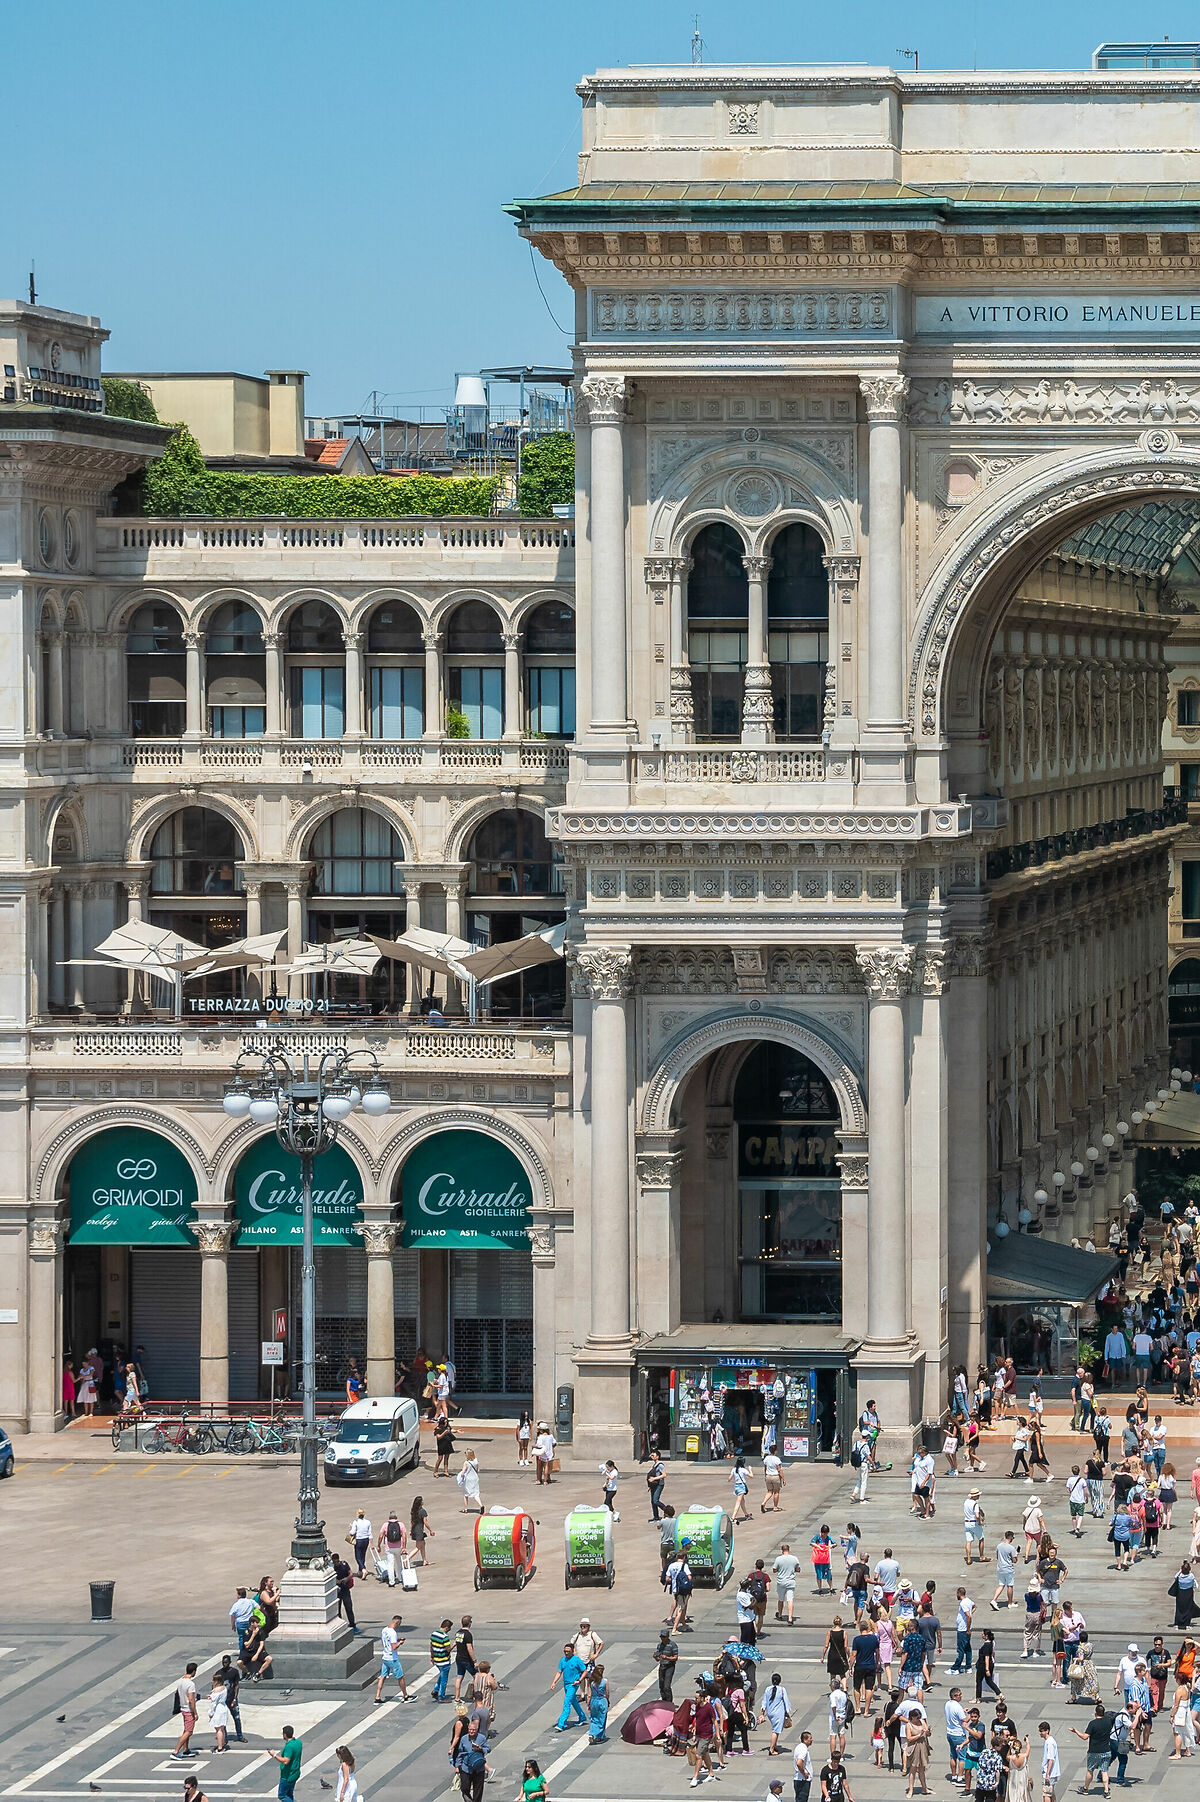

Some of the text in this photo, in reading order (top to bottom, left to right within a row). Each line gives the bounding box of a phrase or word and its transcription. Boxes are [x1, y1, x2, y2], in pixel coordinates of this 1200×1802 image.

[940, 306, 952, 322] A
[969, 306, 1069, 322] VITTORIO
[189, 999, 329, 1012] TERRAZZA DUOMO 21
[92, 1188, 183, 1206] GRIMOLDI
[418, 1173, 527, 1216] Currado
[295, 1206, 356, 1214] GIELLERIE
[464, 1208, 526, 1217] GIOIELLERIE
[241, 1226, 277, 1234] MILANO
[321, 1226, 358, 1234] SANREM
[460, 1229, 477, 1237] ASTI
[490, 1229, 527, 1237] SANREM
